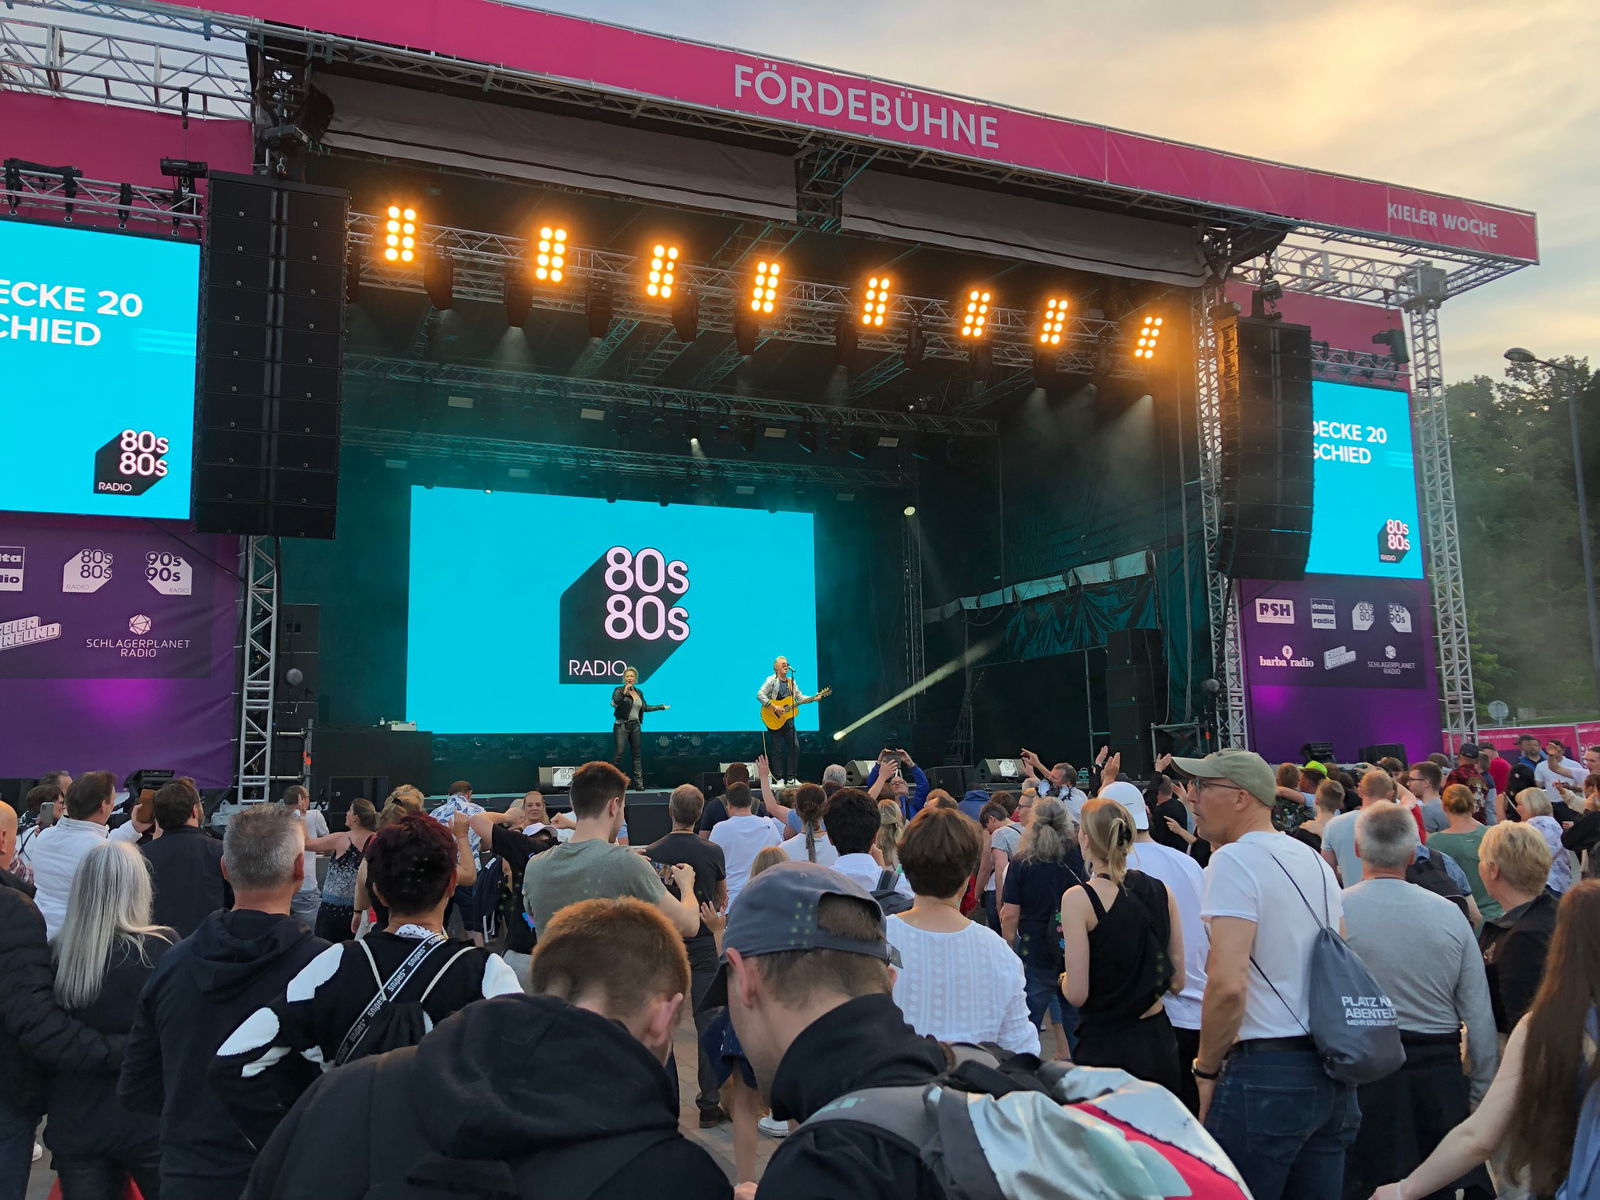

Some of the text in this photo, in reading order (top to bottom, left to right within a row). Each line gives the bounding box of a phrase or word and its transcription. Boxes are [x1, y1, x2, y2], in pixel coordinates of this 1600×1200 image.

[734, 62, 999, 149] FÖRDEBÜHNE
[1387, 202, 1498, 238] KIELER WOCHE
[97, 290, 143, 317] 20
[120, 429, 169, 454] 80s
[1366, 426, 1387, 444] 20
[119, 452, 168, 477] 80s
[98, 482, 132, 492] RADIO
[1386, 519, 1409, 535] 80s
[1388, 534, 1411, 550] 80s
[81, 550, 113, 565] 80s
[146, 552, 181, 567] 90s
[80, 564, 112, 579] 80s
[145, 567, 181, 582] 90s
[604, 546, 690, 594] 80s
[604, 594, 690, 641] 80s
[1389, 613, 1406, 623] 90s
[86, 639, 190, 649] SCHLAGERPLANET
[120, 648, 157, 658] RADIO
[568, 660, 627, 676] RADIO
[1259, 656, 1287, 667] barba
[1290, 657, 1314, 668] radio
[1341, 996, 1378, 1007] PLATZ
